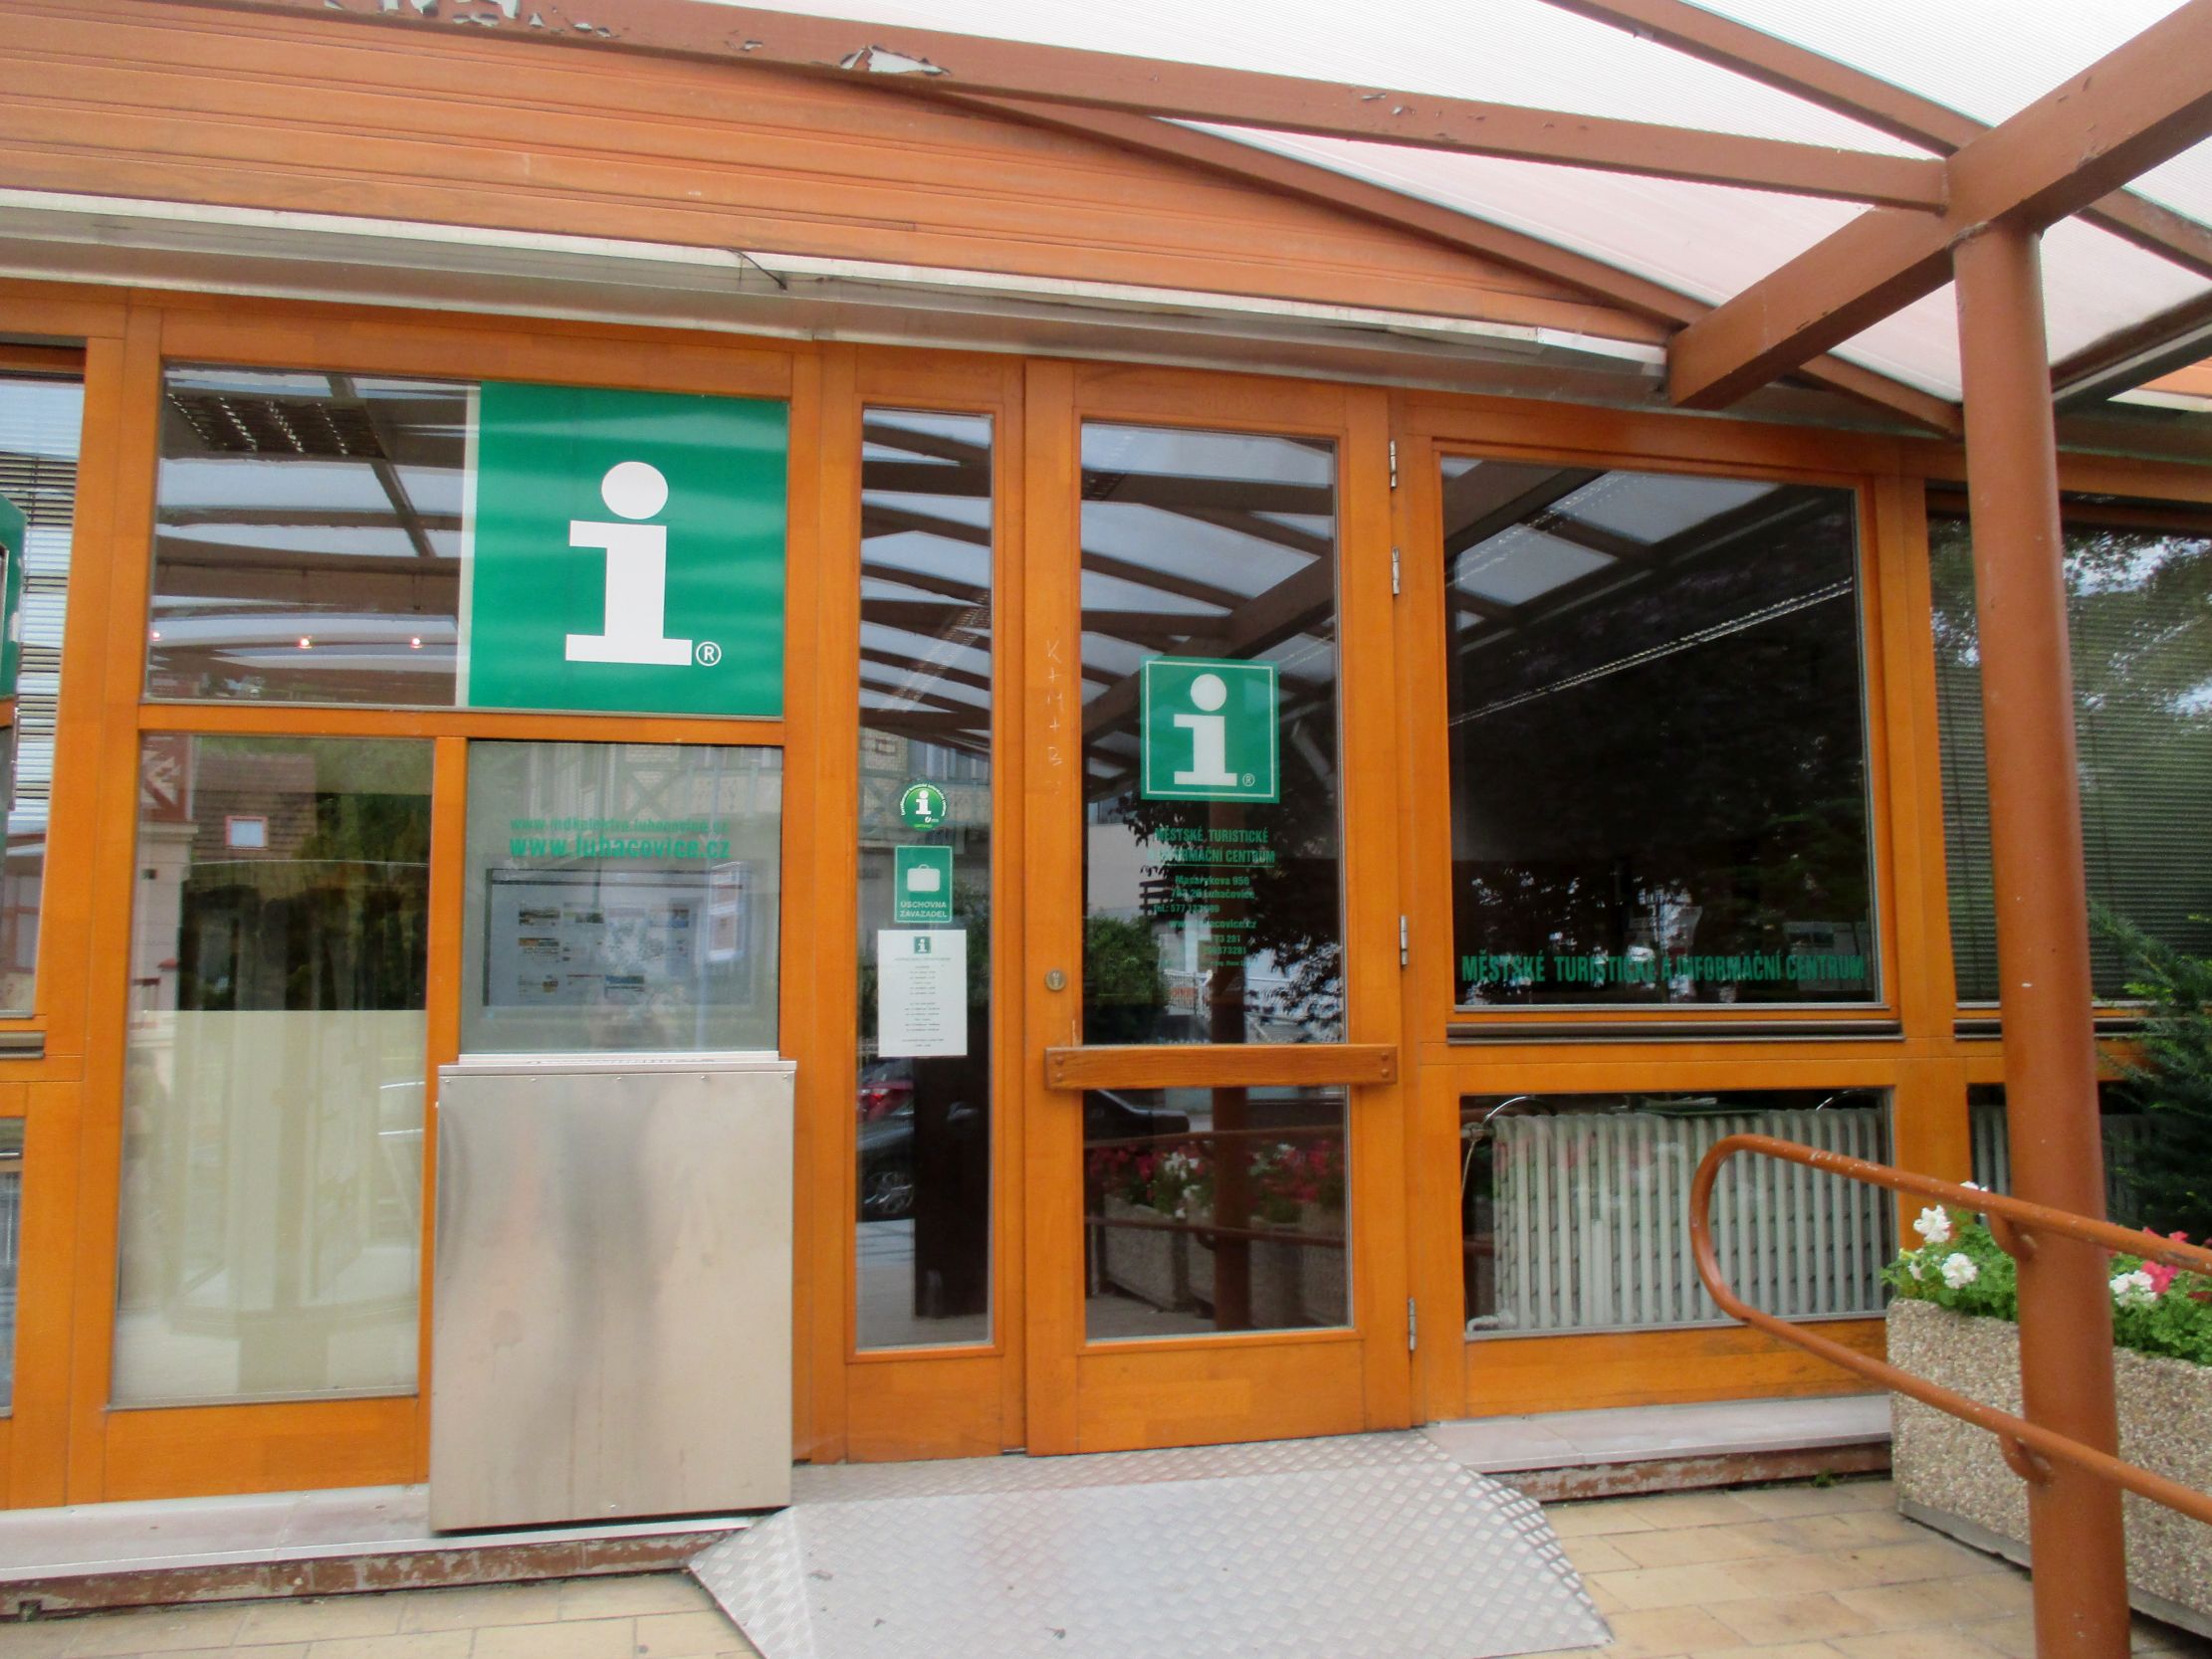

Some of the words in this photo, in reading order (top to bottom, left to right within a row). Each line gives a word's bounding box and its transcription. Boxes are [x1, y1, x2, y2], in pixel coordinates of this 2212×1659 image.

[1209, 827, 1269, 843] TURISTICKÉ
[510, 834, 733, 858] www.luhacovice.cz
[1225, 849, 1275, 863] CENTRUM
[1461, 948, 1546, 982] MĚSTSKÉ
[1661, 955, 1672, 981] A
[1675, 949, 1781, 981] INFORMAČNÍ
[1785, 954, 1865, 980] CENTRUM
